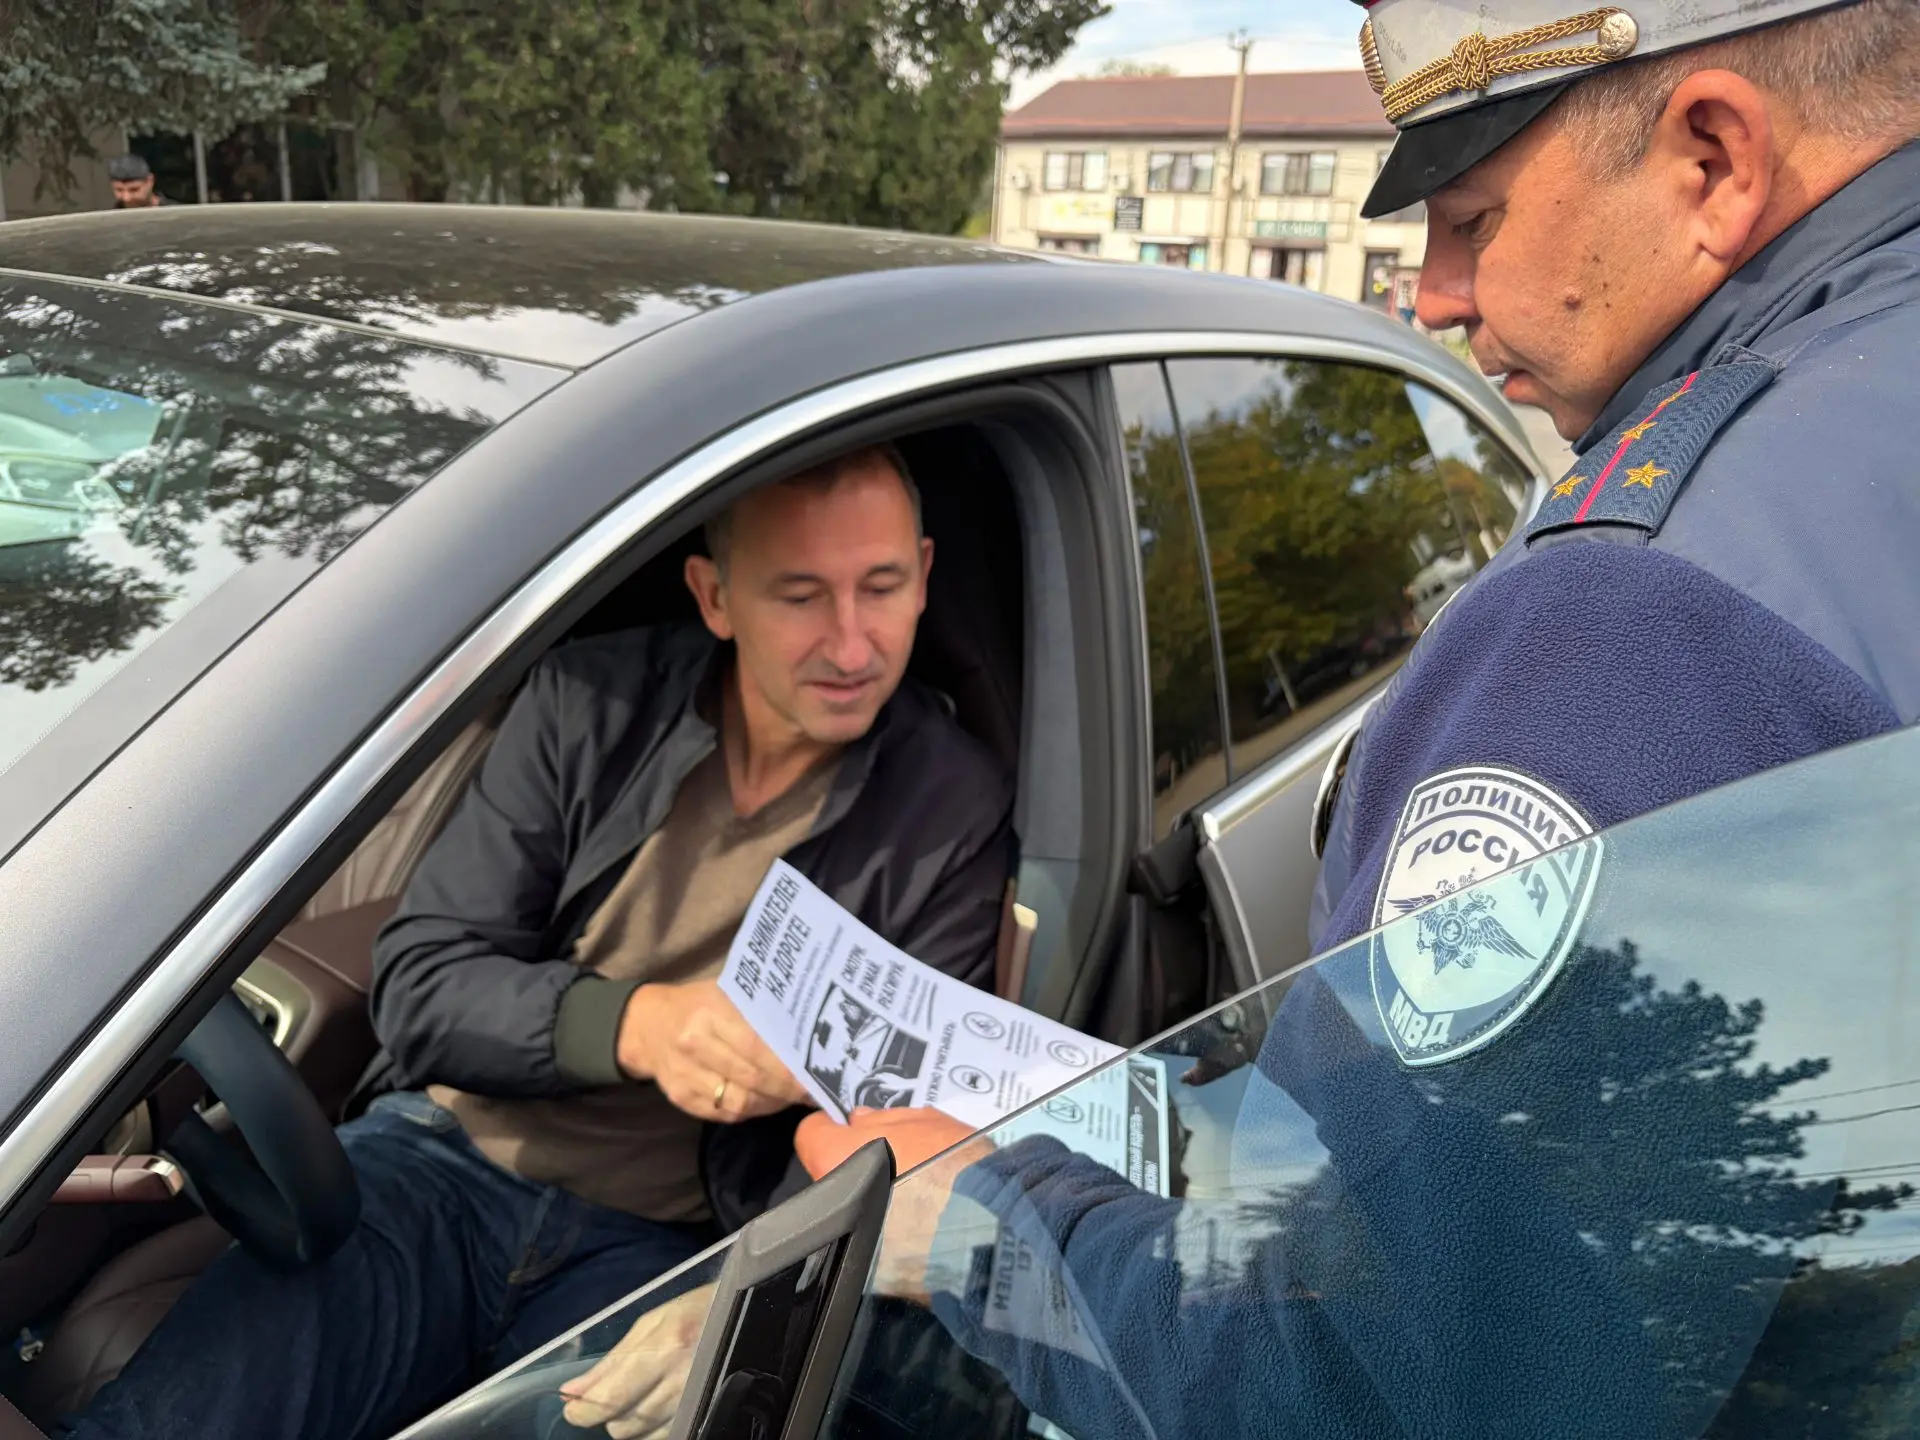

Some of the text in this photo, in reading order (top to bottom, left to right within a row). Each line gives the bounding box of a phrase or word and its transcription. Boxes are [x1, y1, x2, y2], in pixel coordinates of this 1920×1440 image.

[1414, 785, 1577, 873] ПОЛИЦИЯ
[735, 871, 801, 1000] БУДЬ ВНИМАТЕЛЕН
[772, 914, 812, 986] ДОРОГЕ!
[764, 969, 786, 1002] НА
[1389, 988, 1454, 1048] МВД
